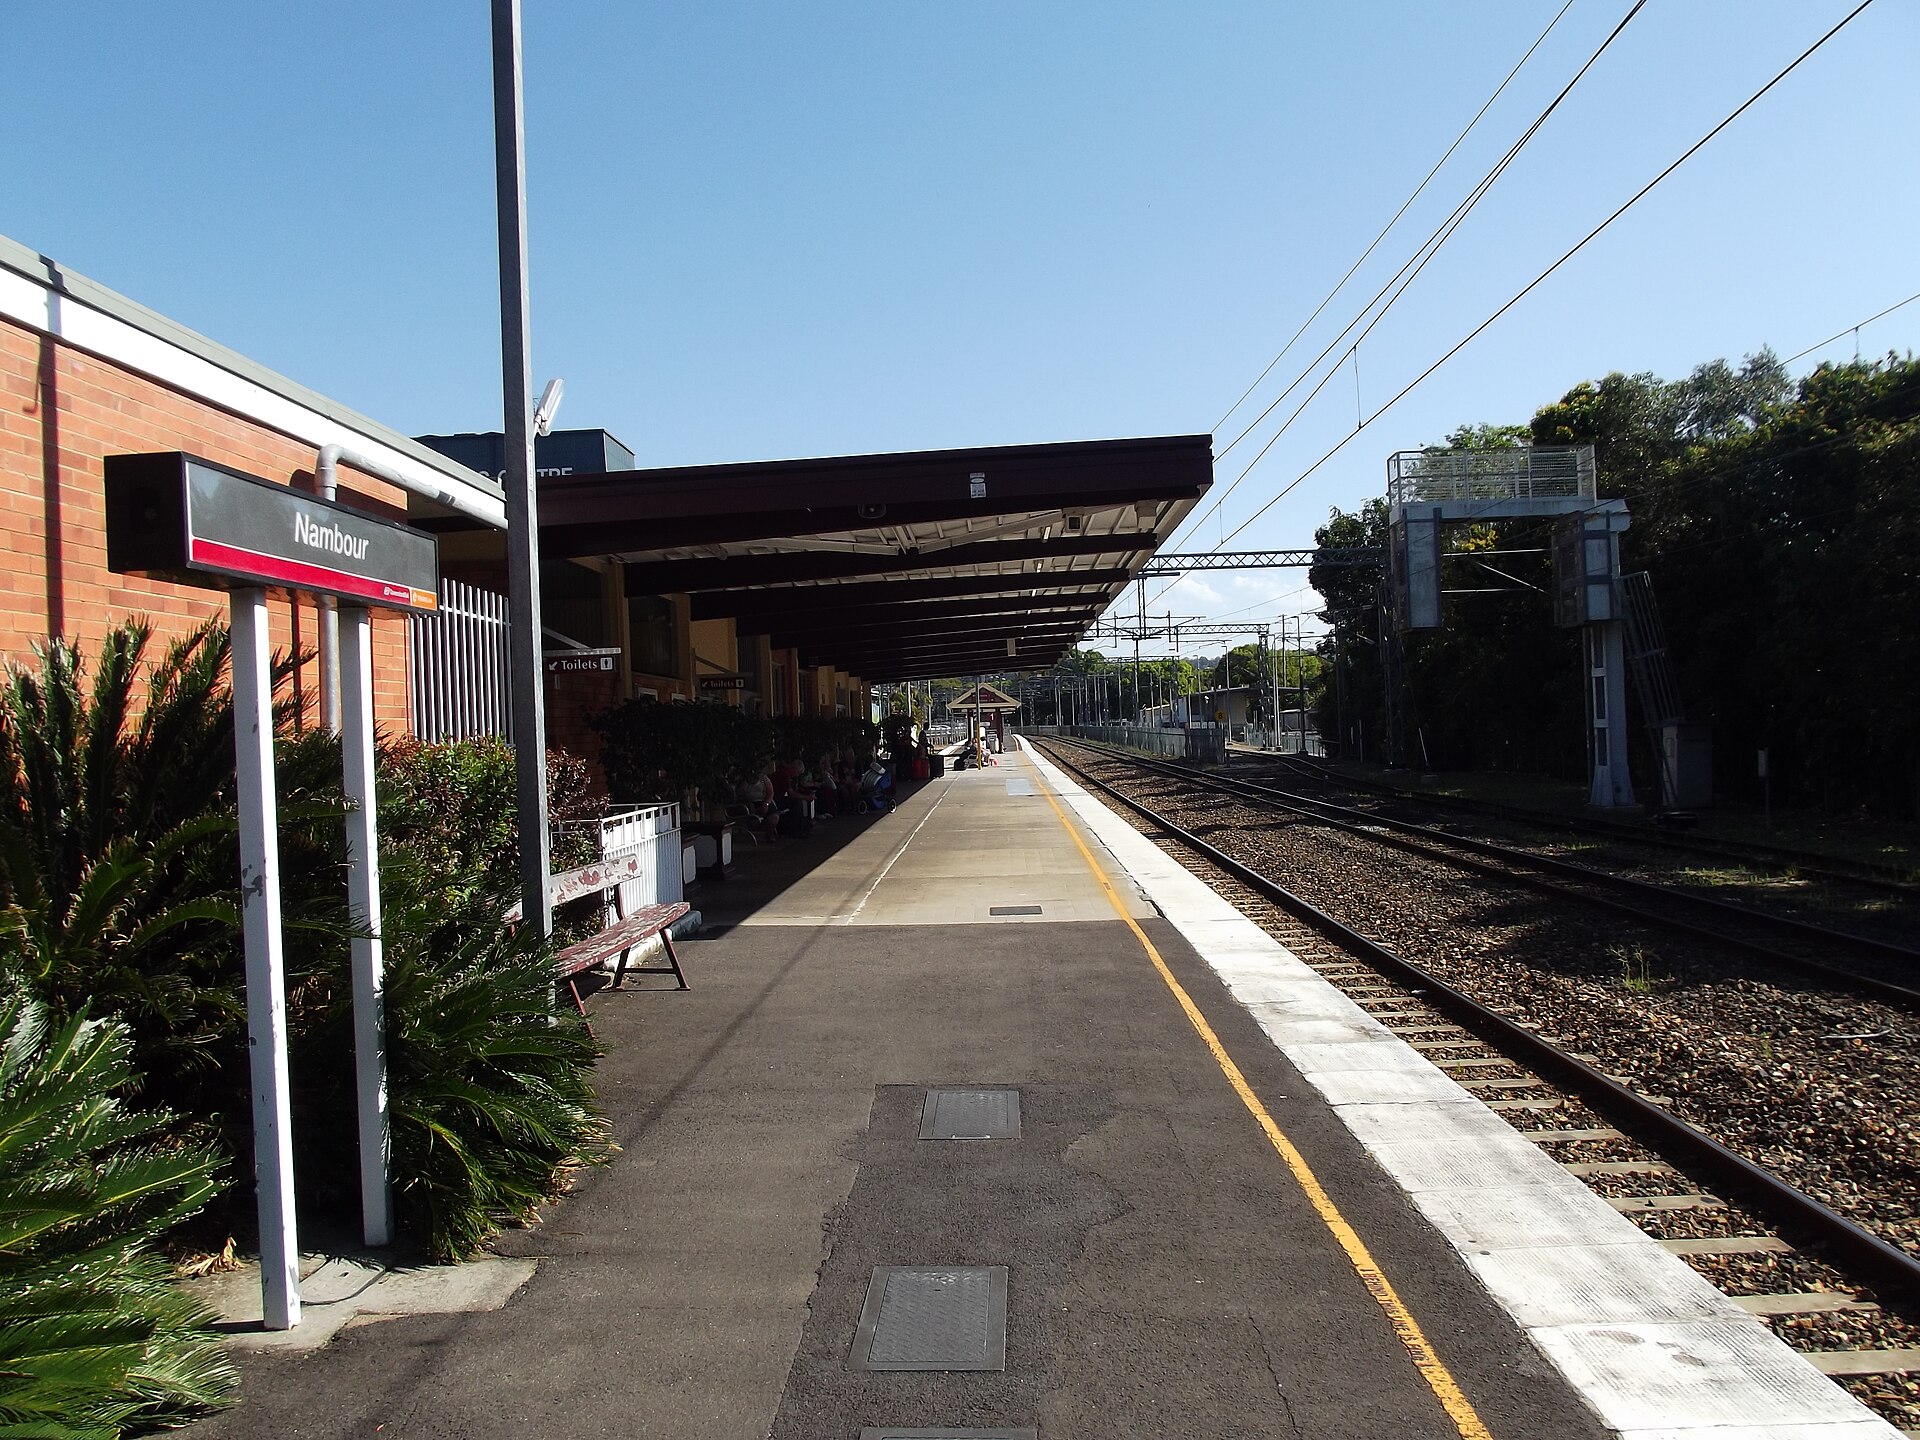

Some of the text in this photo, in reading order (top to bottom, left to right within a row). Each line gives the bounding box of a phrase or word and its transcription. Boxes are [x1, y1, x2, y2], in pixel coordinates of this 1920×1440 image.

[294, 511, 370, 560] Nambour
[561, 658, 598, 670] Toilets
[709, 679, 734, 688] Toilets
